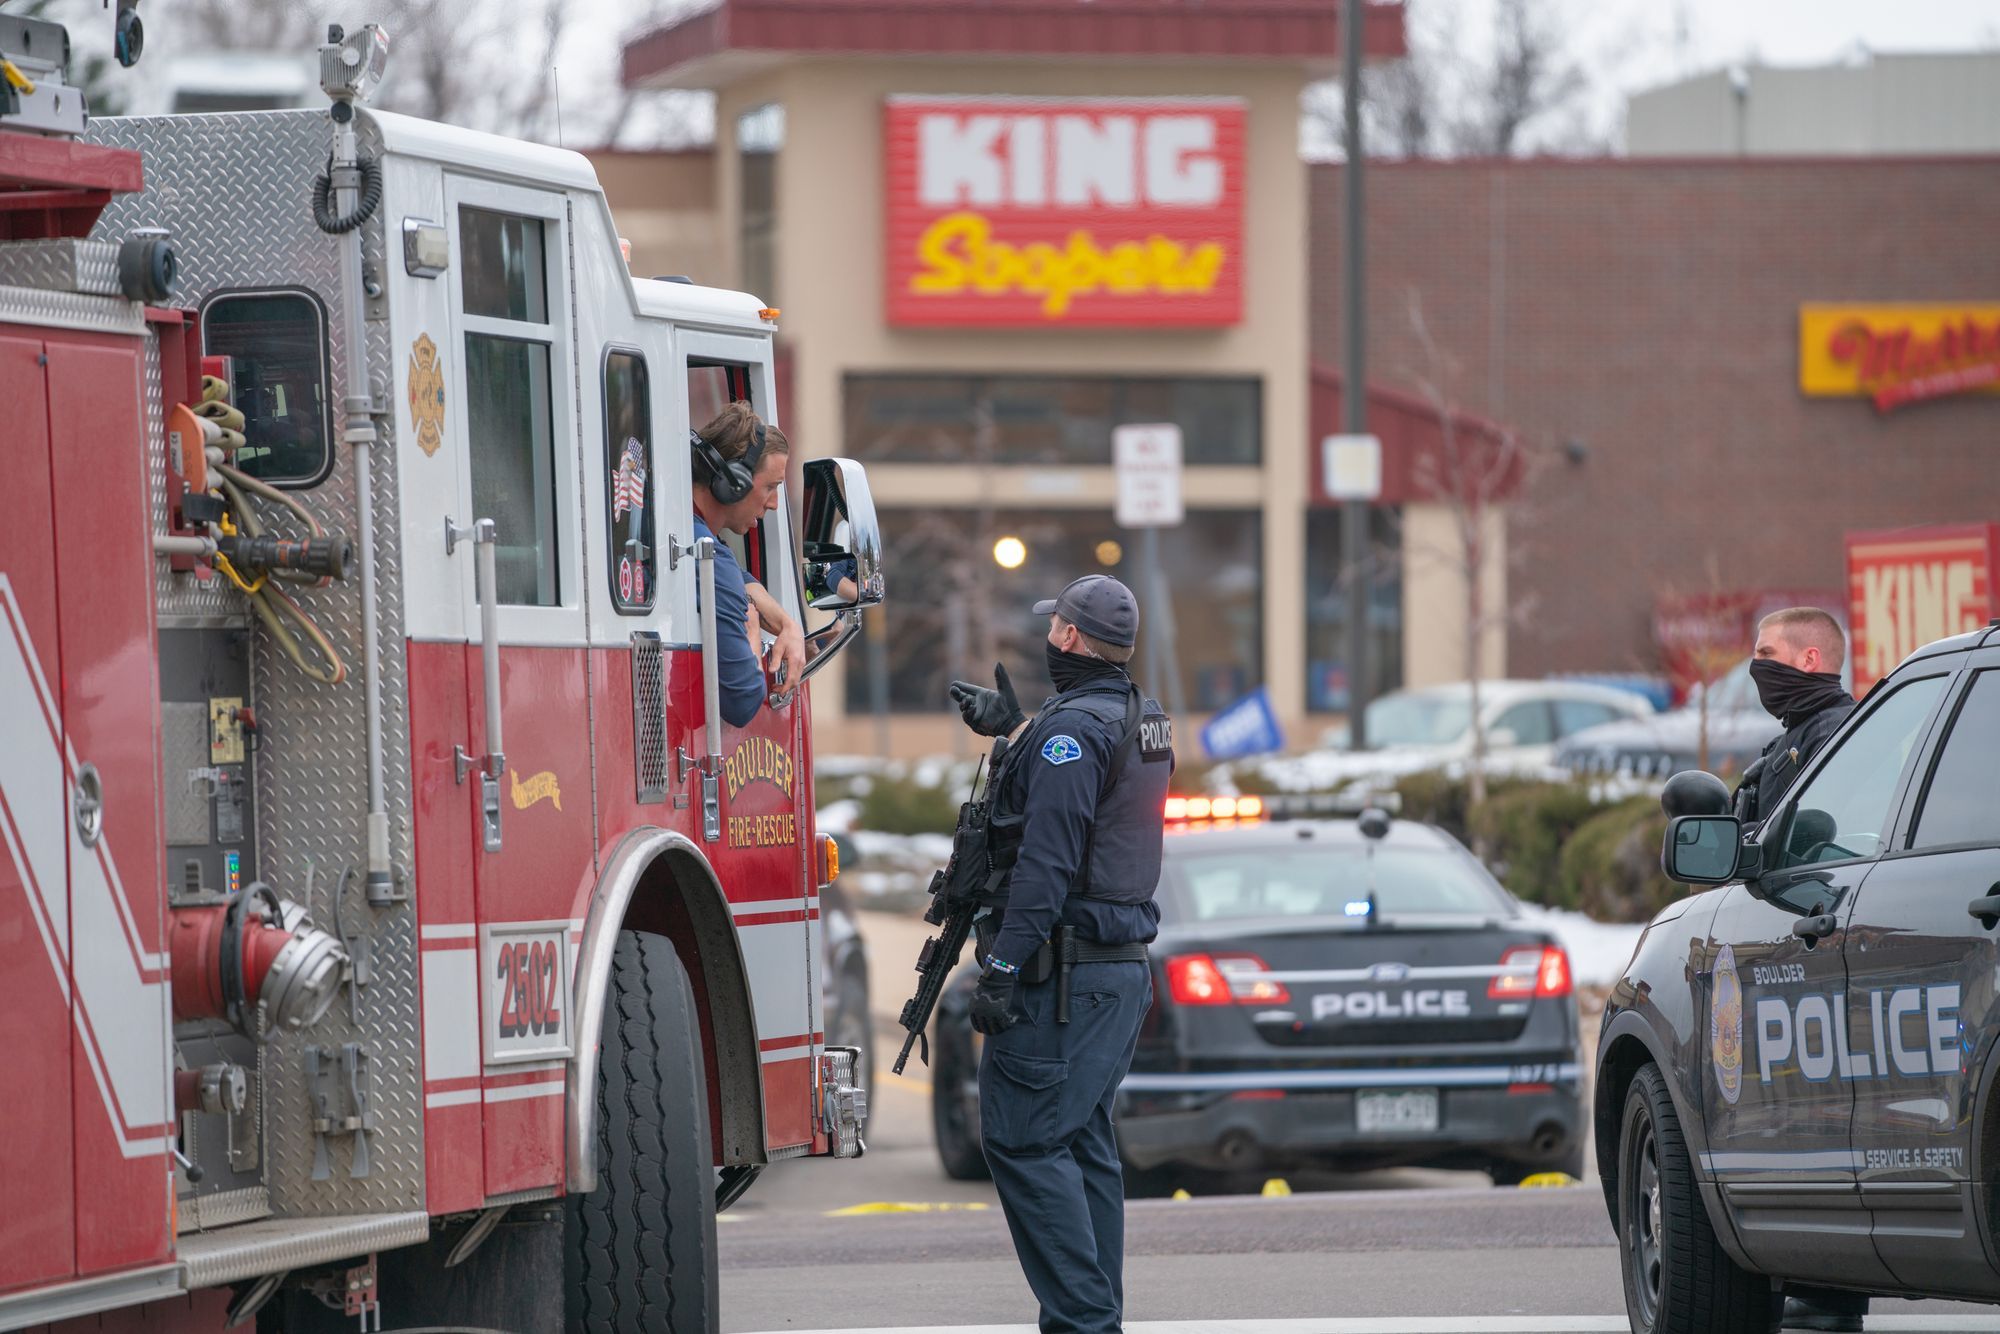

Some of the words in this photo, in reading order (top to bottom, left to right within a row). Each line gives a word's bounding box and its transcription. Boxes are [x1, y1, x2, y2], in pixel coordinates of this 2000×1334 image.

[917, 113, 1224, 207] KING
[911, 212, 1226, 318] Soopers
[725, 736, 793, 804] BOULDER
[497, 939, 560, 1038] 2502
[1312, 989, 1470, 1020] POLICE
[1753, 963, 1805, 985] BOULDER
[1756, 982, 1961, 1086] POLICE
[1866, 1148, 1911, 1169] SERVICE
[1914, 1148, 1921, 1167] &
